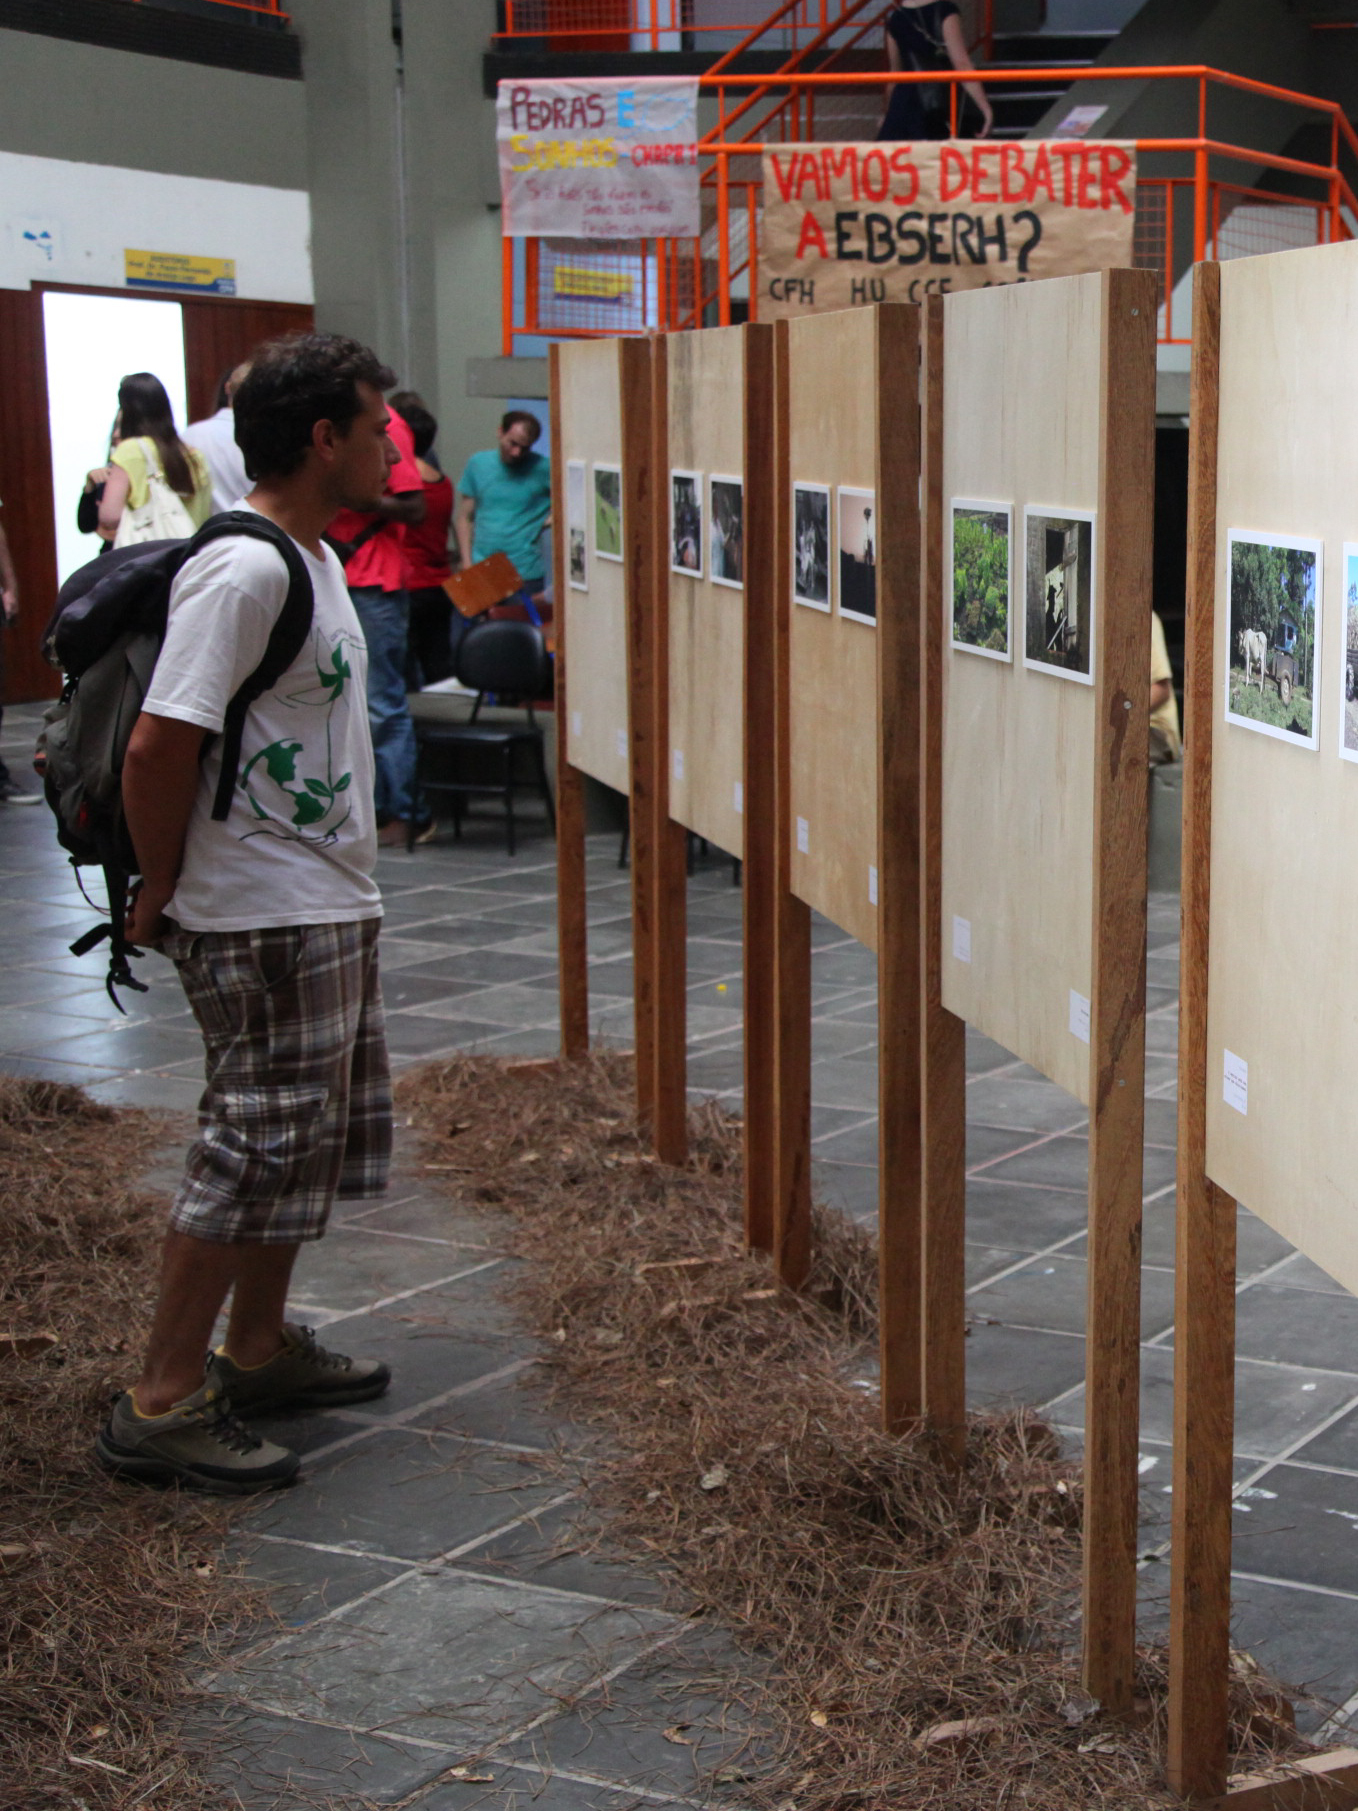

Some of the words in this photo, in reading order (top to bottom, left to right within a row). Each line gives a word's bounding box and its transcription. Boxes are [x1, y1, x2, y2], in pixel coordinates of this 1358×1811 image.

[616, 90, 635, 128] E
[770, 146, 920, 206] VAMOS
[939, 142, 1135, 216] DEBATER
[795, 210, 830, 259] A
[835, 210, 1043, 273] EBSERH?
[769, 278, 815, 305] CFH
[851, 277, 886, 304] HU
